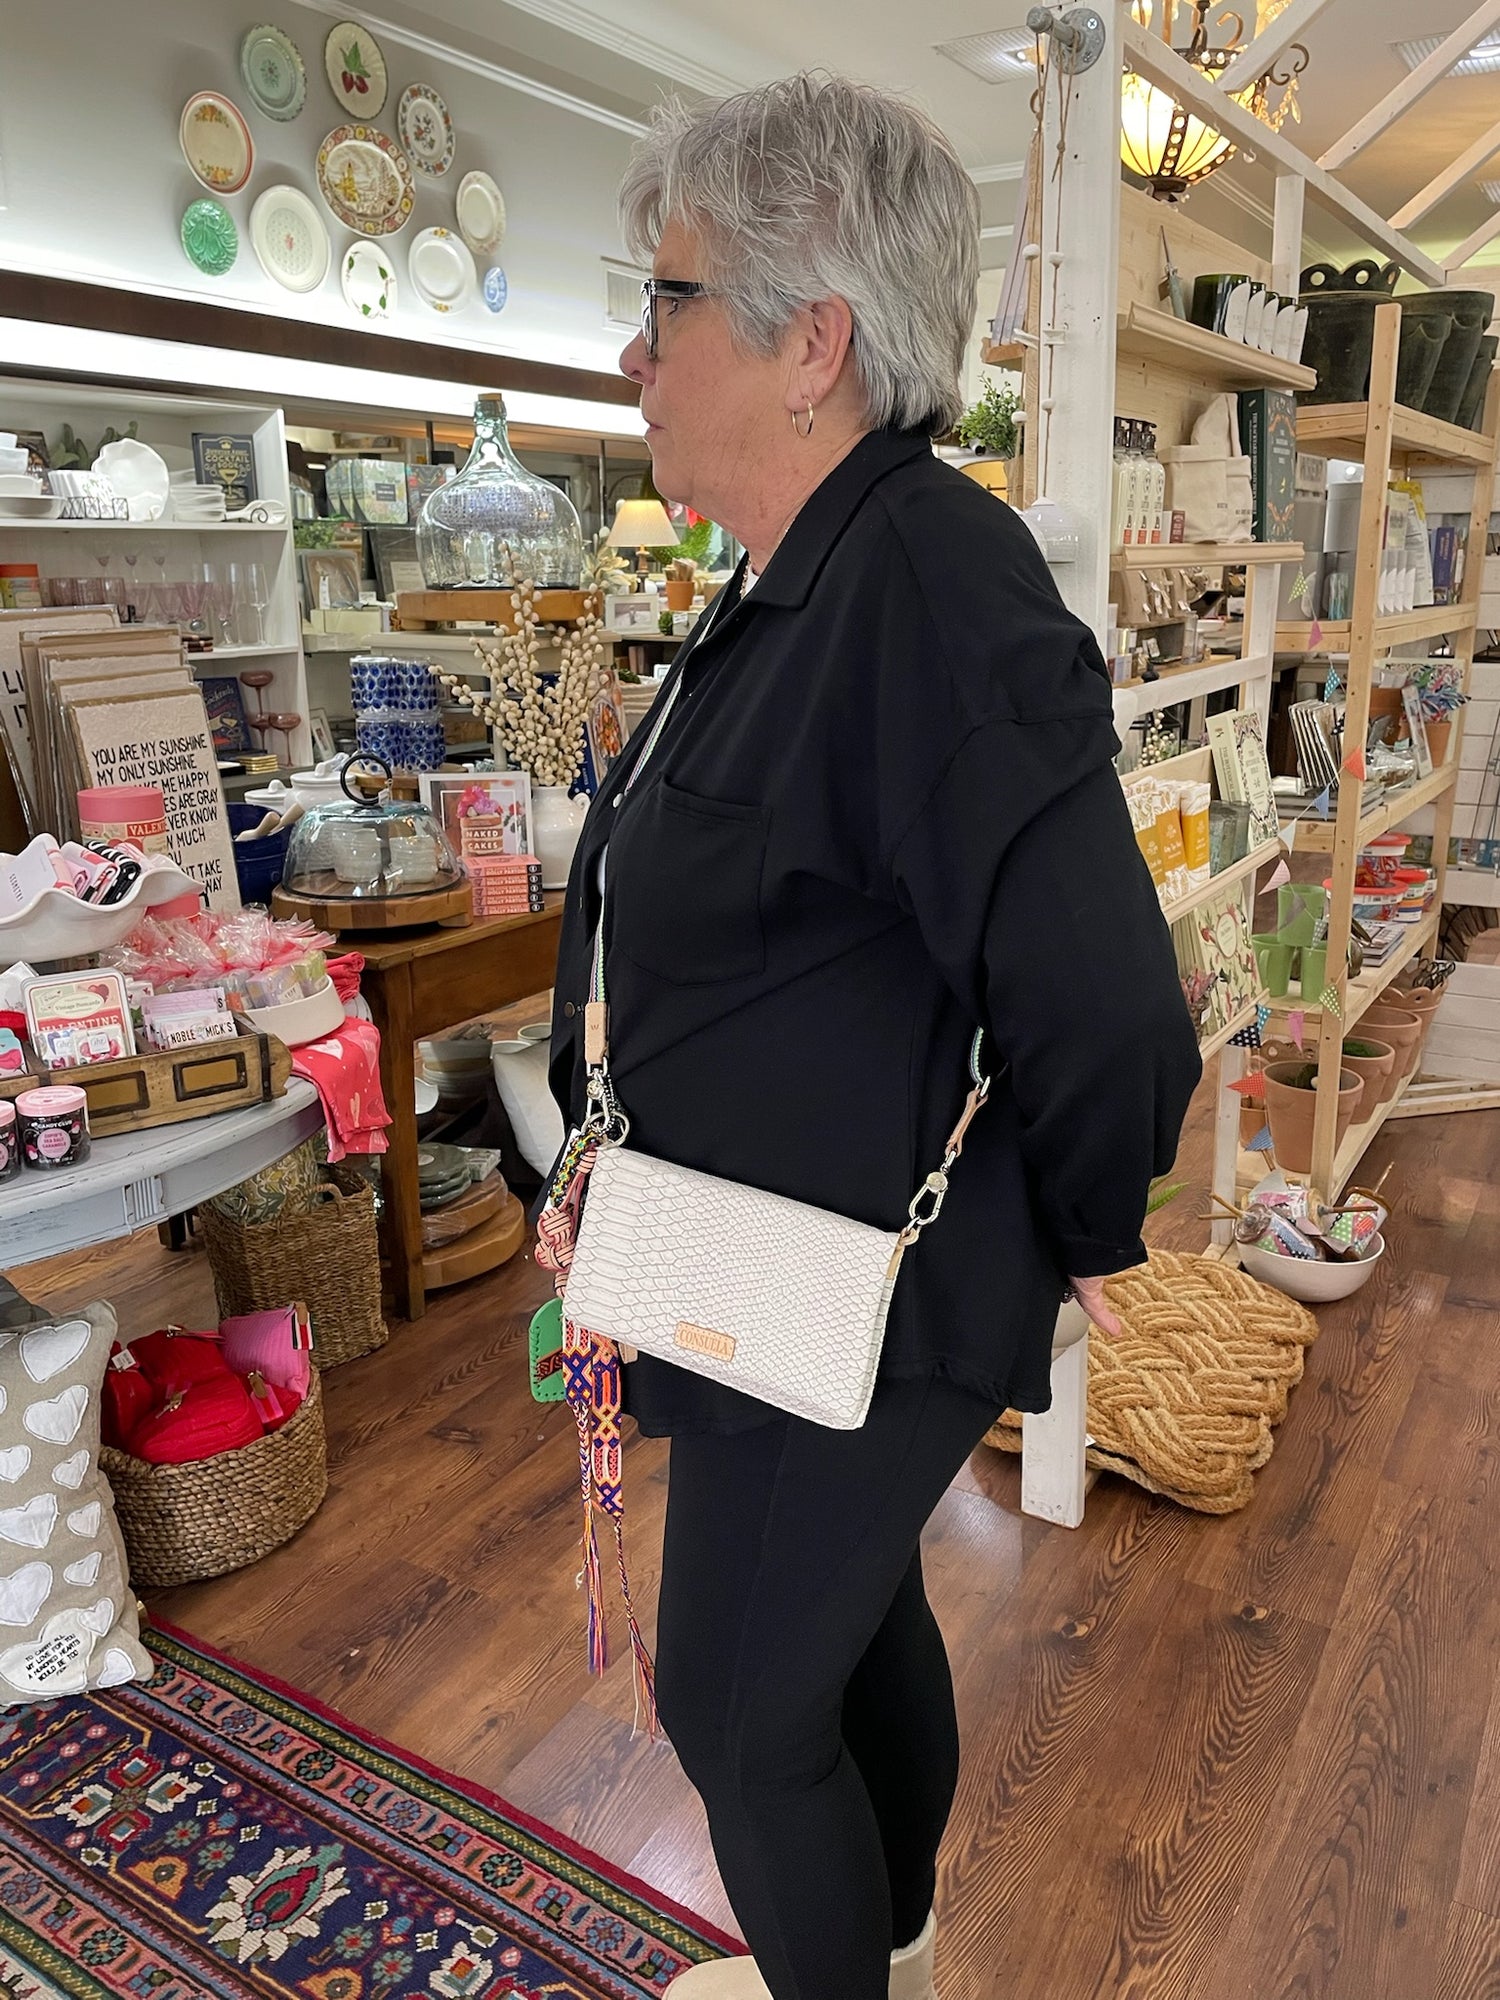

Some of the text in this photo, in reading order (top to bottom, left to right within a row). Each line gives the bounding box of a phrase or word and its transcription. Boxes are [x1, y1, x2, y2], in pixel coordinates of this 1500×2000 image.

[92, 734, 208, 767] YOU ARE MY SUNSHINE
[96, 754, 197, 786] MY ONLY SUNSHINE
[161, 777, 177, 794] ME
[178, 771, 210, 790] HAPPY
[179, 792, 196, 810] ARE
[197, 788, 218, 805] GRAY
[128, 823, 166, 837] VALEN
[165, 806, 218, 833] VER KNOW
[176, 827, 206, 847] MUCH
[466, 830, 499, 838] NAKED
[468, 841, 498, 850] CAKES
[198, 859, 222, 878] TAKE
[203, 876, 222, 893] WAY
[170, 1021, 233, 1044] NOBLE MICK'S
[680, 1329, 728, 1355] CONSUELA
[34, 1655, 58, 1676] HUNDRED
[60, 1639, 81, 1656] HEARTS
[35, 1652, 51, 1664] LOVE
[52, 1641, 64, 1654] FOR
[65, 1633, 76, 1642] YOU
[38, 1650, 79, 1681] WOULD BE TOO
